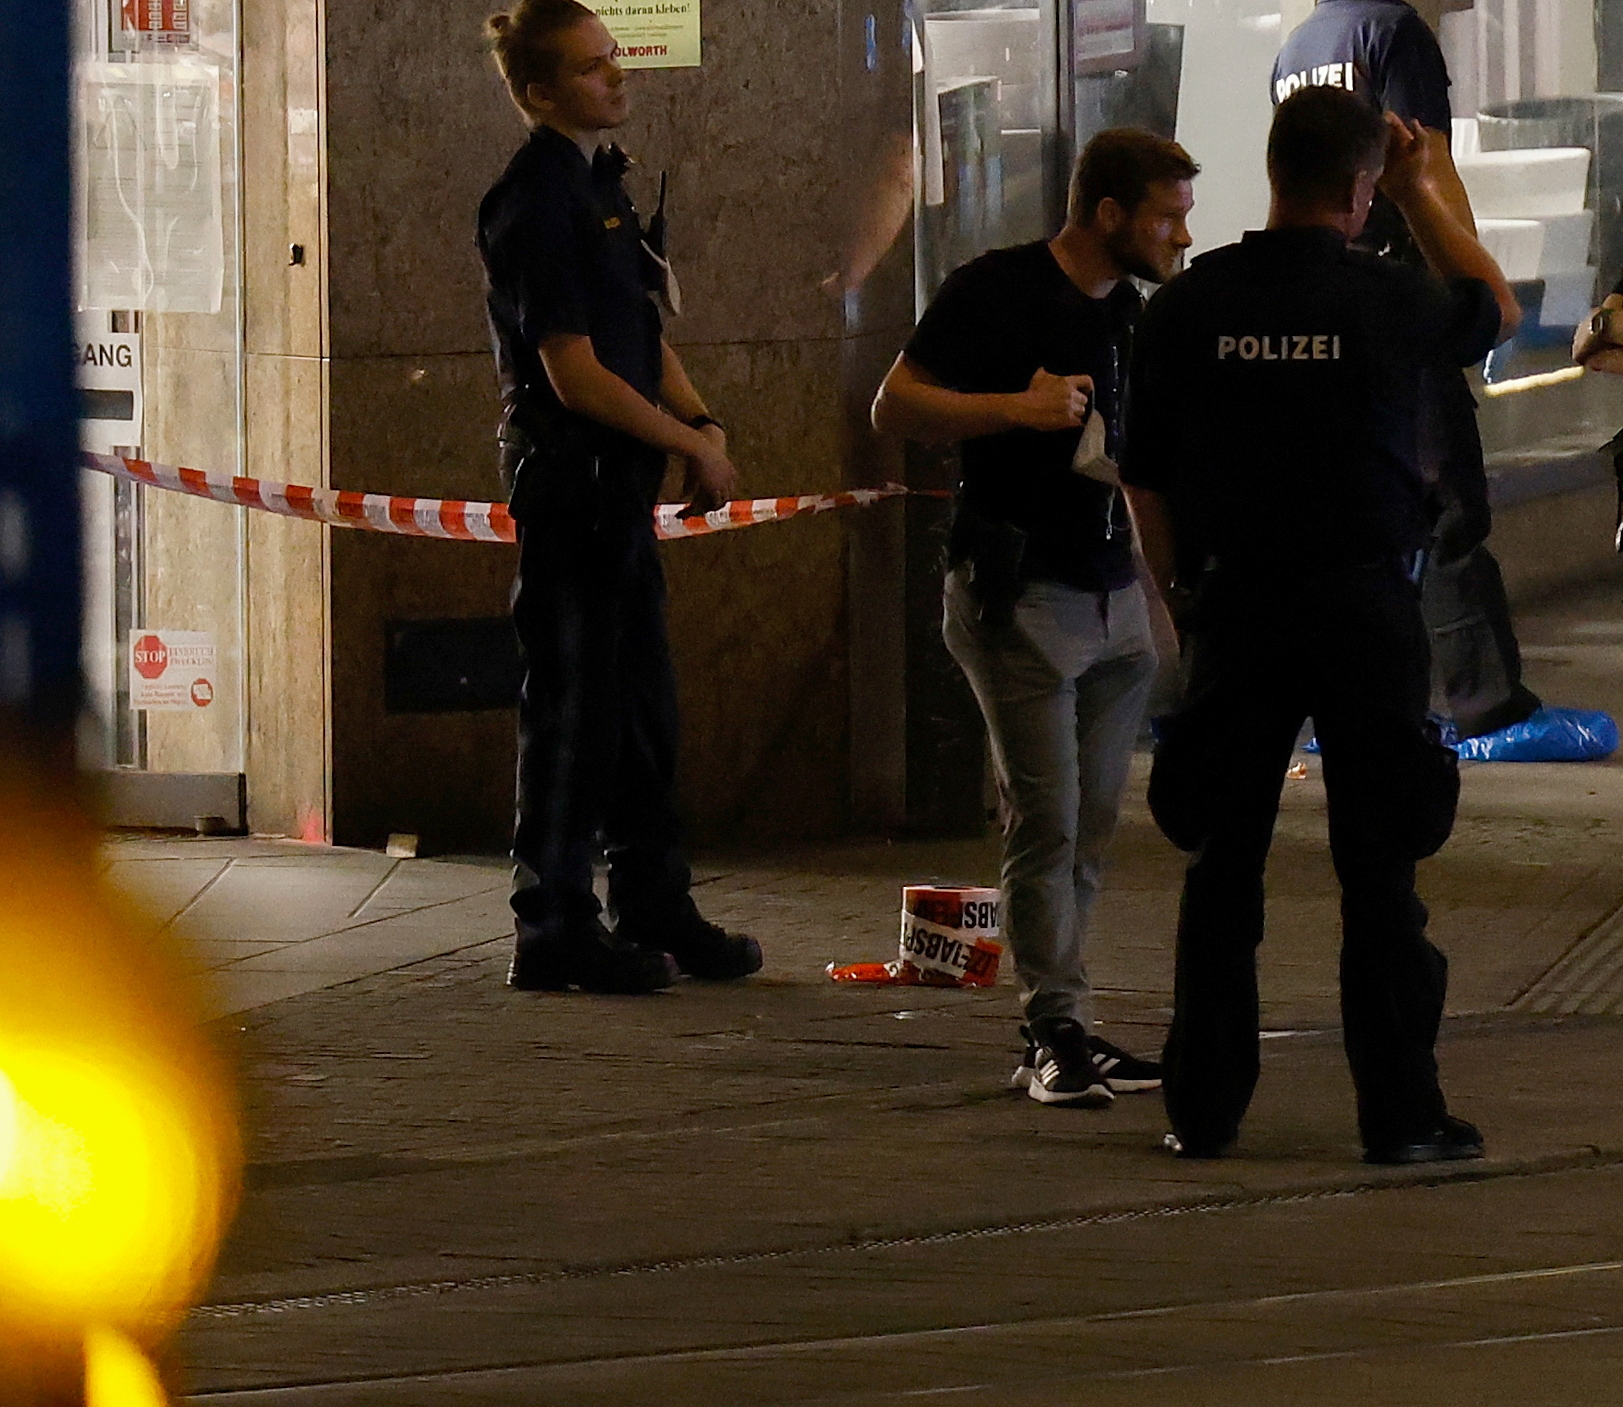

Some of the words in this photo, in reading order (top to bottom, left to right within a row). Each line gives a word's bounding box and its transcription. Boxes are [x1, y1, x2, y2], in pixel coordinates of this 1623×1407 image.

[595, 5, 623, 16] nichts
[625, 4, 653, 15] daran
[655, 3, 691, 15] kleben!
[613, 45, 668, 57] OLWORTH
[82, 342, 133, 368] ANG
[1218, 335, 1341, 361] POLIZEI
[135, 650, 166, 663] STOP
[960, 901, 1000, 930] ABS
